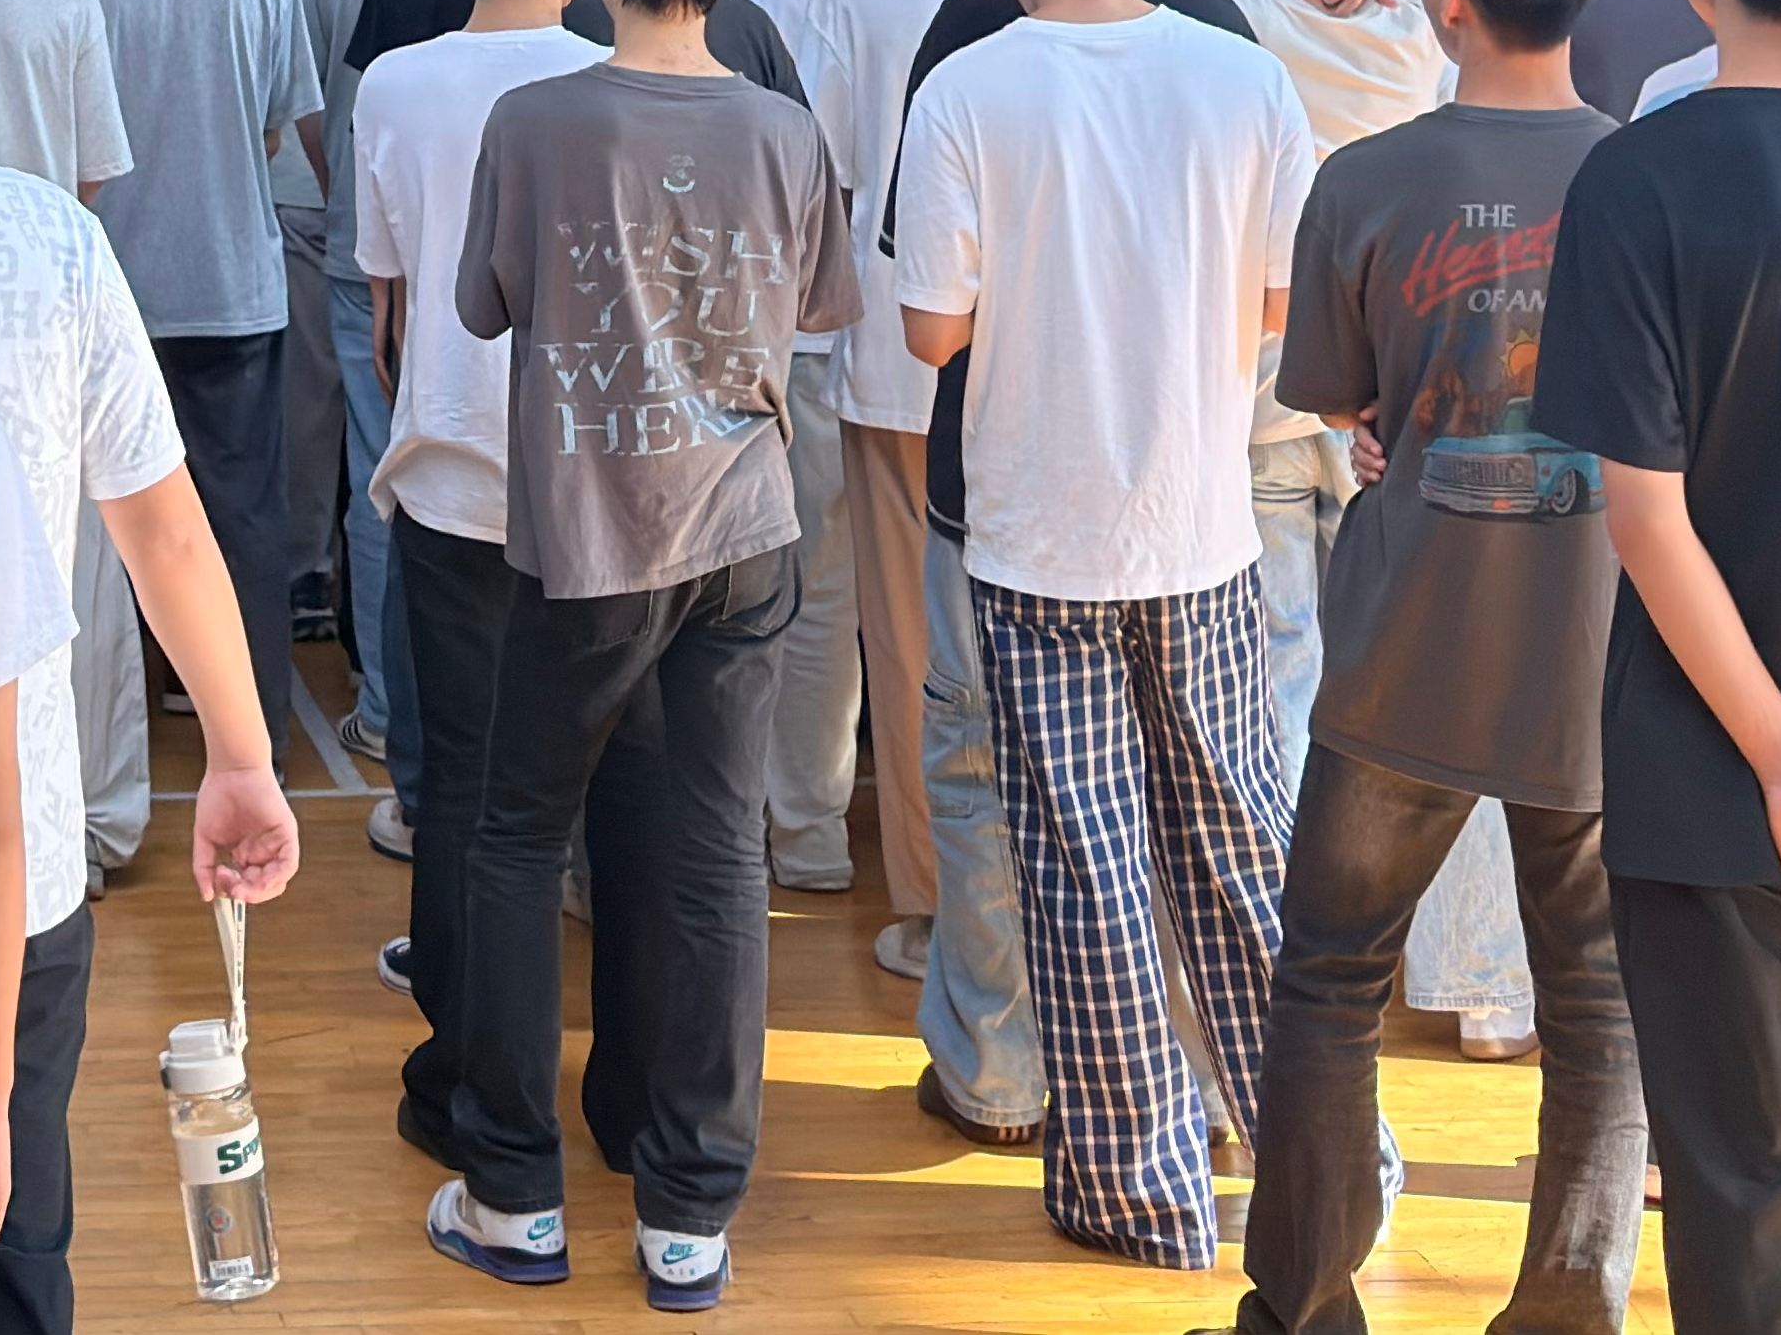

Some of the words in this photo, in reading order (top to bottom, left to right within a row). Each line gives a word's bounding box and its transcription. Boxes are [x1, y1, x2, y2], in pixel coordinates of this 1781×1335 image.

[1459, 203, 1517, 228] THE
[556, 221, 787, 285] WISH
[571, 280, 760, 337] YOU
[1467, 288, 1505, 313] OF
[534, 1215, 558, 1232] NIKE
[667, 1241, 695, 1257] NIKE
